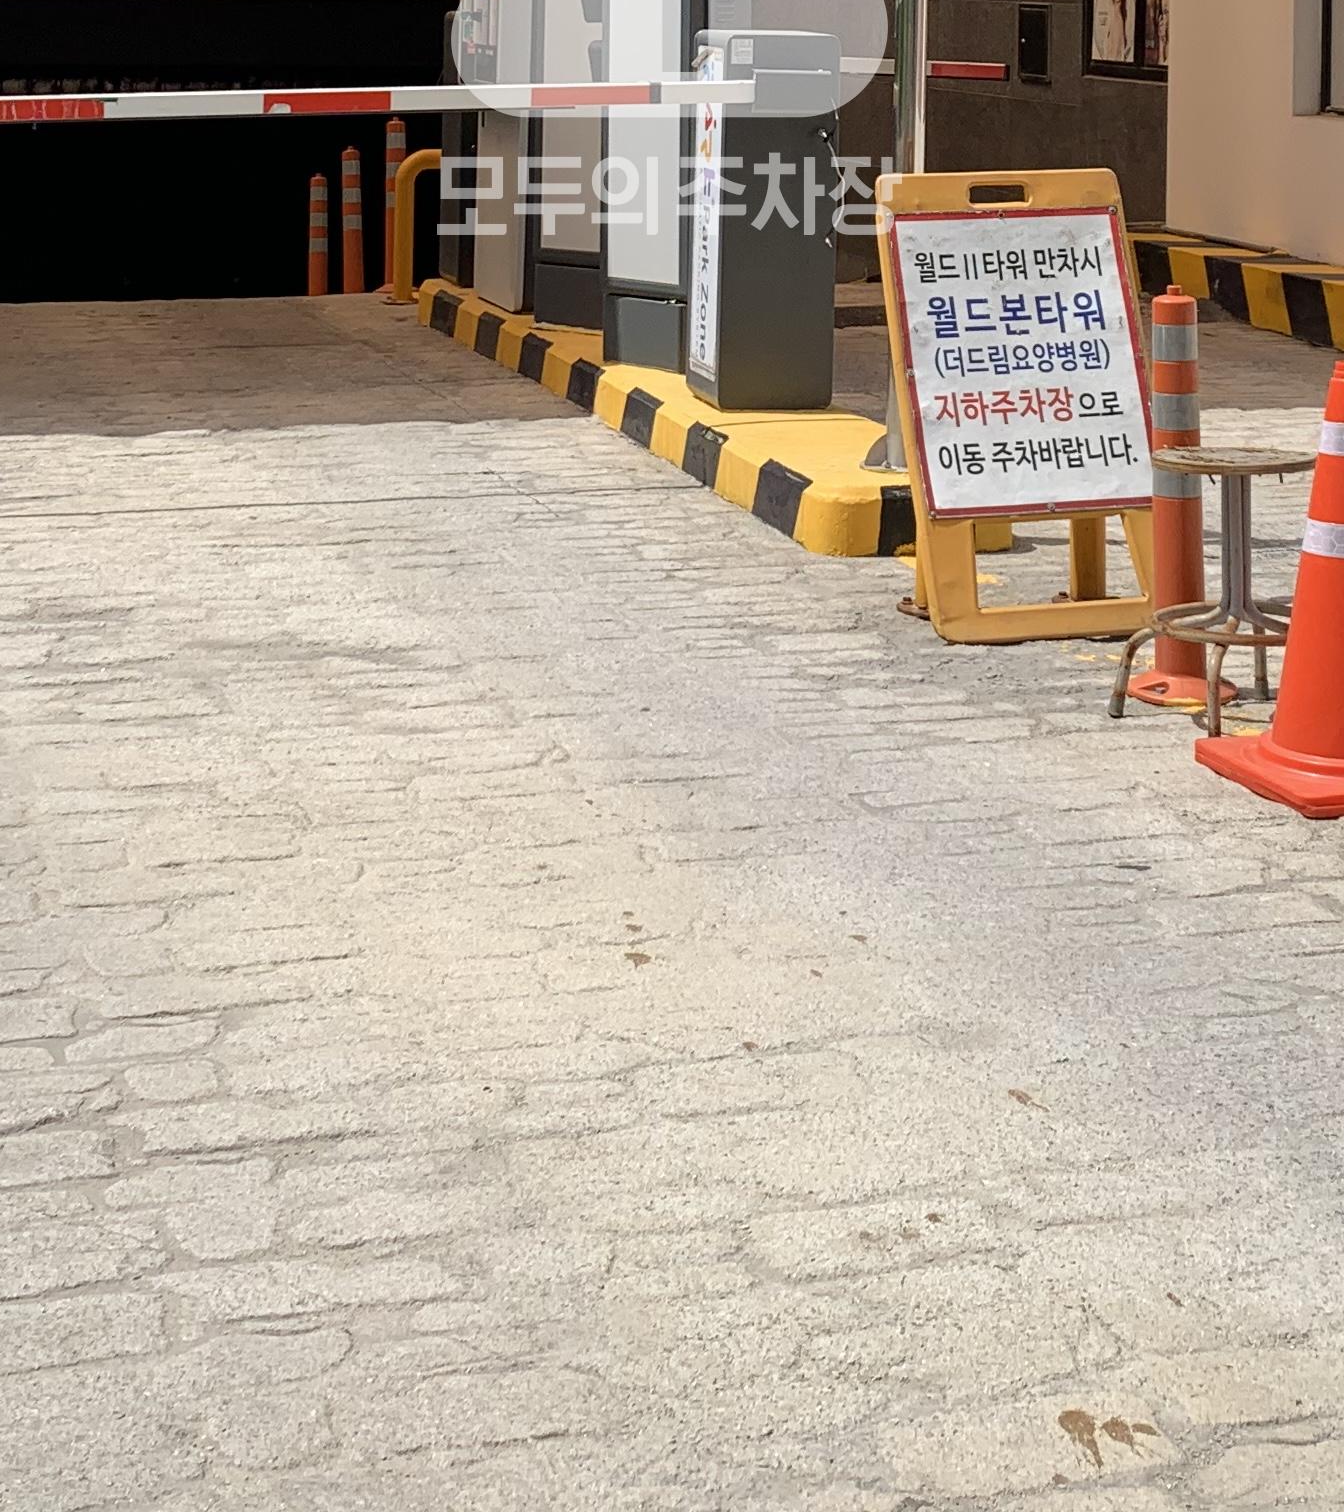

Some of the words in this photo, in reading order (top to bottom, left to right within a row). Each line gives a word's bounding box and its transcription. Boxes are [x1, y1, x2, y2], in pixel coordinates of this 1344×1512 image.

[1033, 245, 1103, 281] 만차시
[697, 282, 711, 363] Zone
[926, 290, 1108, 340] 월드본타워
[933, 338, 1111, 379] (더드림요양병원)
[937, 441, 986, 477] 이동
[990, 433, 1140, 476] 주차바랍니다.
